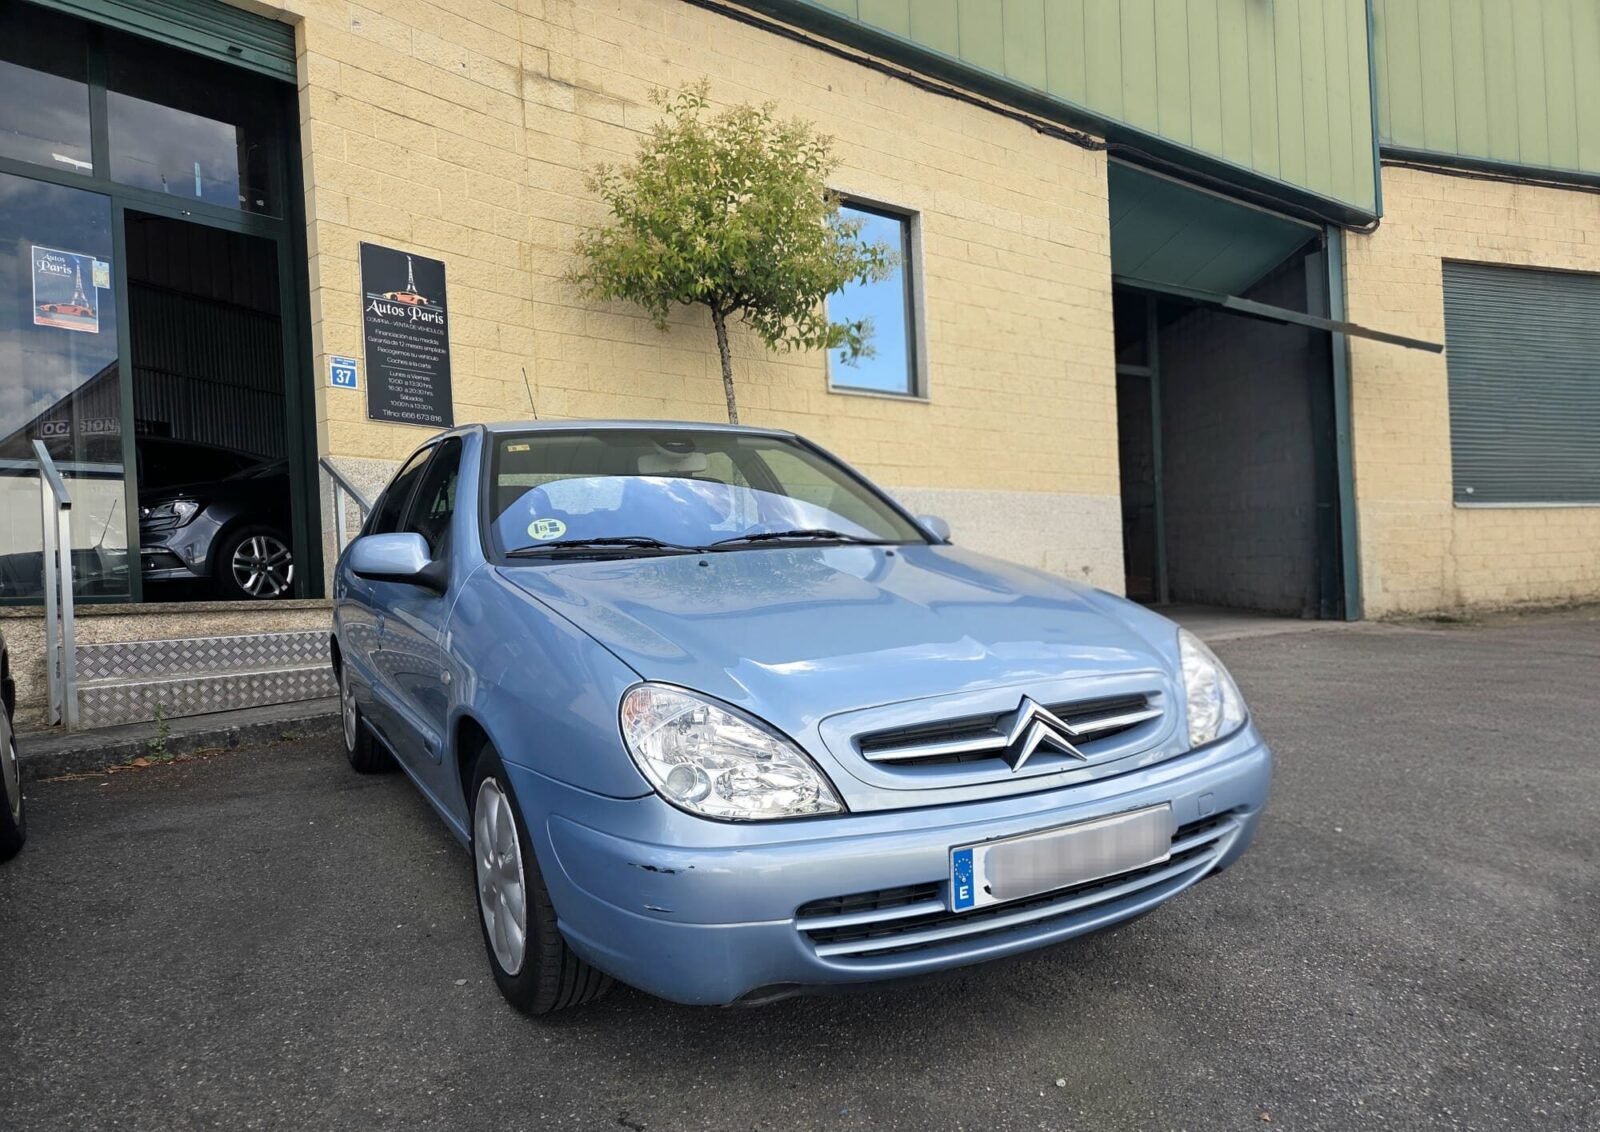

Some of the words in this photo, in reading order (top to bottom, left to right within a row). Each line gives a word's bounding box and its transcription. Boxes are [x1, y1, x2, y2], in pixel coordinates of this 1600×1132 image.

[42, 253, 65, 262] Autos
[366, 300, 405, 317] Autos
[336, 369, 351, 384] 37
[417, 412, 430, 421] 673
[959, 886, 969, 900] E
